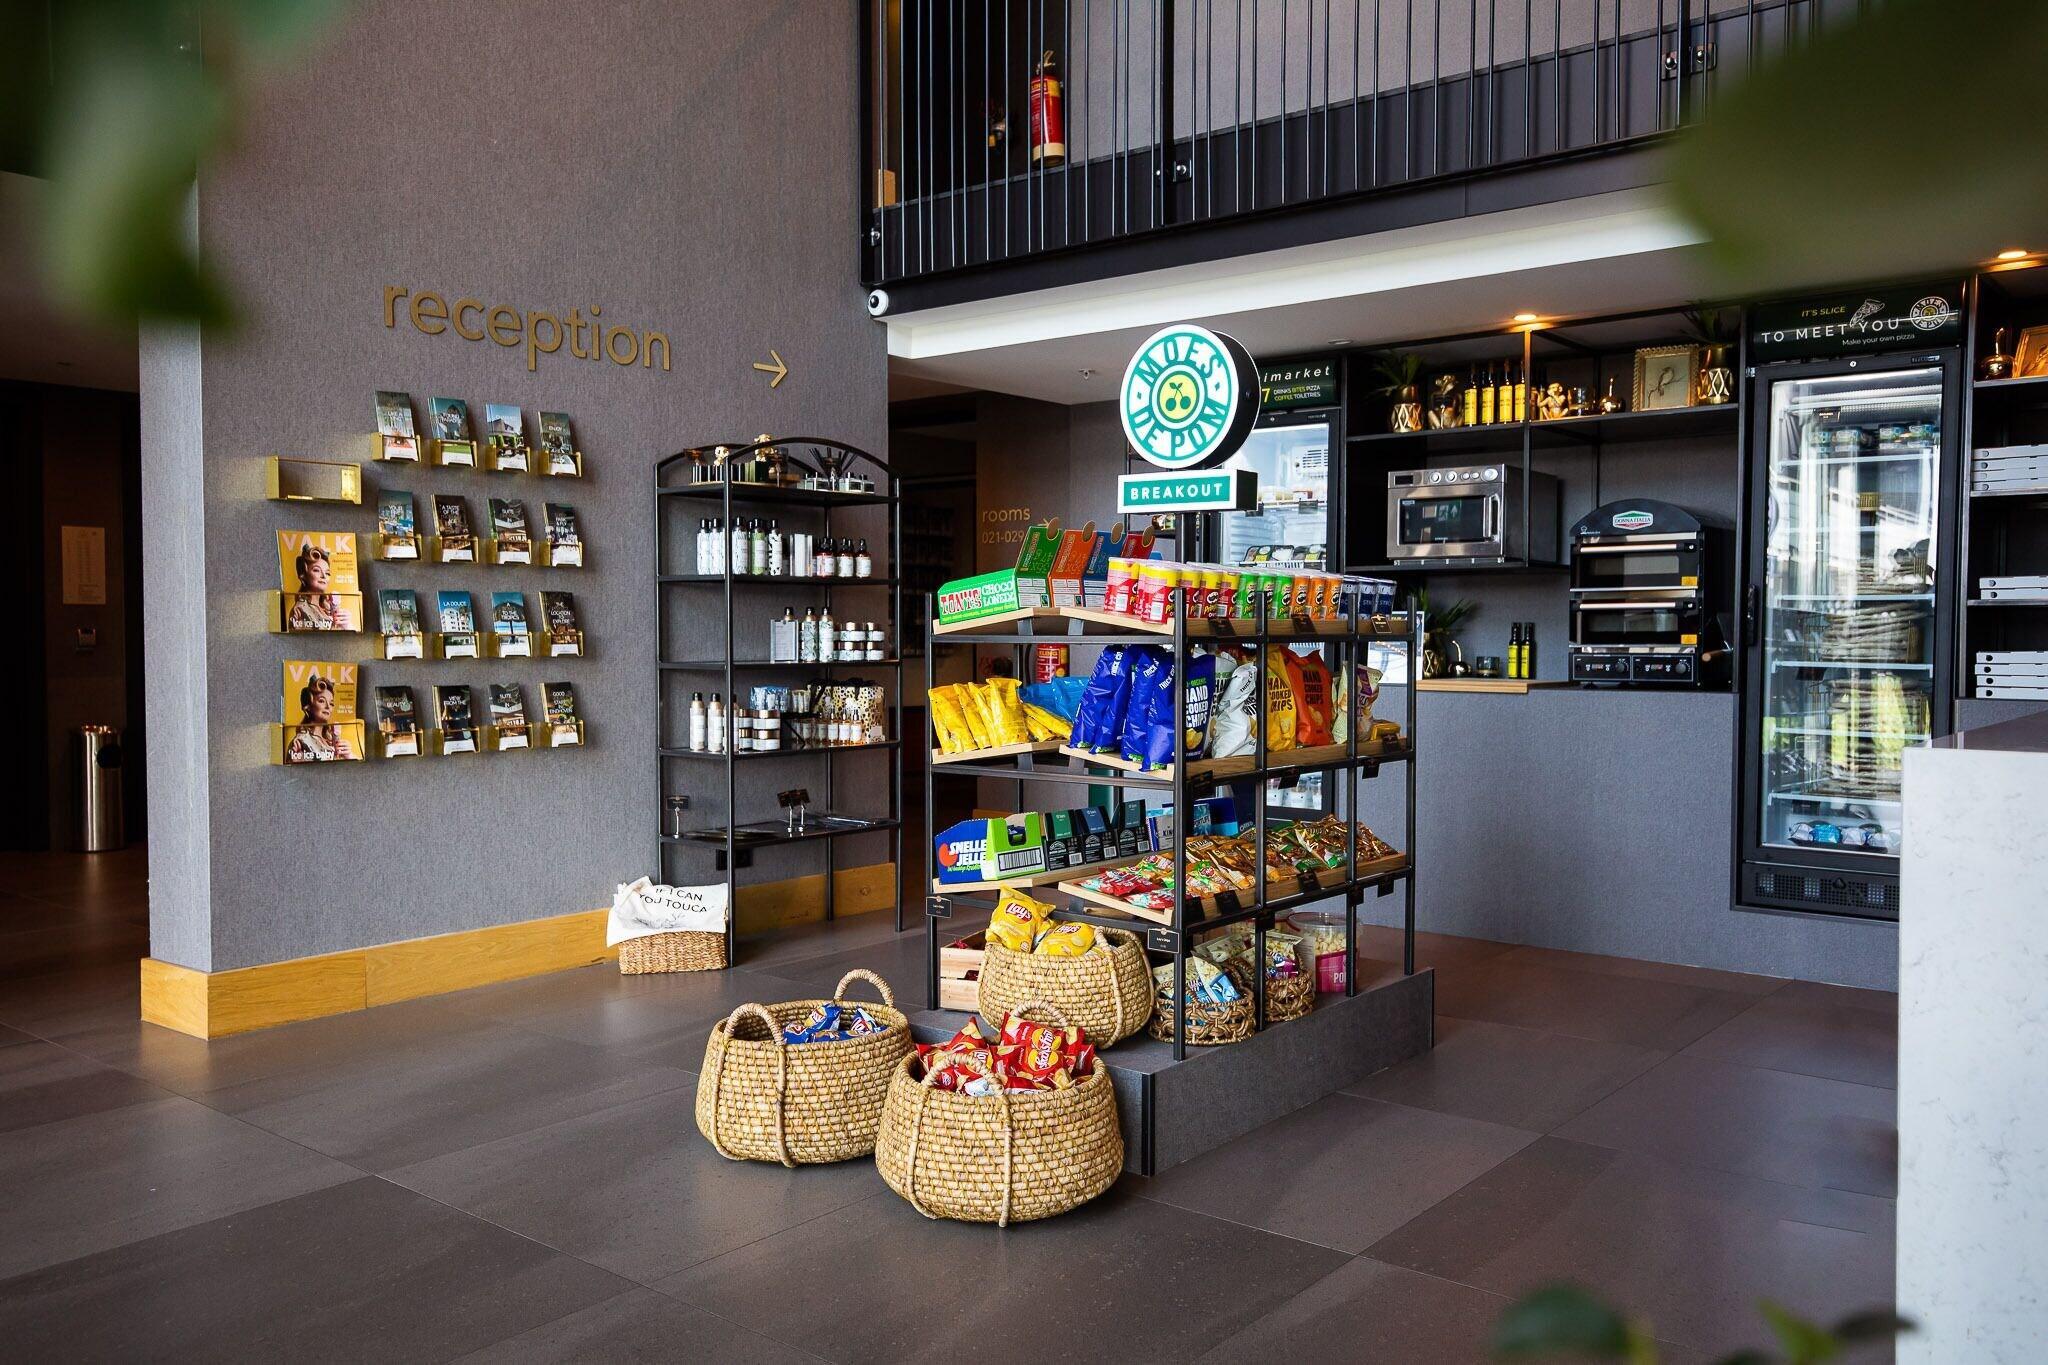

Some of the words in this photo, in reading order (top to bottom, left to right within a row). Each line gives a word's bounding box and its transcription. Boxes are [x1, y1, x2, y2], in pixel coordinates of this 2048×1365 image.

[1801, 308, 1818, 318] IT'S
[1820, 306, 1846, 315] SLICE
[383, 285, 671, 372] reception
[1762, 331, 1785, 344] TO
[1796, 324, 1849, 340] MEET
[1858, 318, 1899, 333] YOU
[1842, 338, 1861, 346] Make
[1862, 337, 1879, 346] your
[1896, 333, 1915, 342] pizza
[1263, 365, 1330, 383] imarket
[1274, 387, 1291, 395] DRINKS
[1130, 482, 1223, 501] BREAKOUT
[982, 507, 1031, 523] rooms
[282, 533, 353, 553] VALK
[982, 530, 1026, 544] 021-029
[982, 580, 1014, 595] CHOCO
[304, 620, 314, 628] ice
[288, 664, 355, 684] VALK
[1303, 670, 1322, 682] HAND
[1305, 694, 1323, 705] CHIPS
[304, 751, 315, 760] ice
[949, 839, 987, 856] SNELLE
[956, 852, 987, 866] JELLE
[676, 890, 704, 901] CAN
